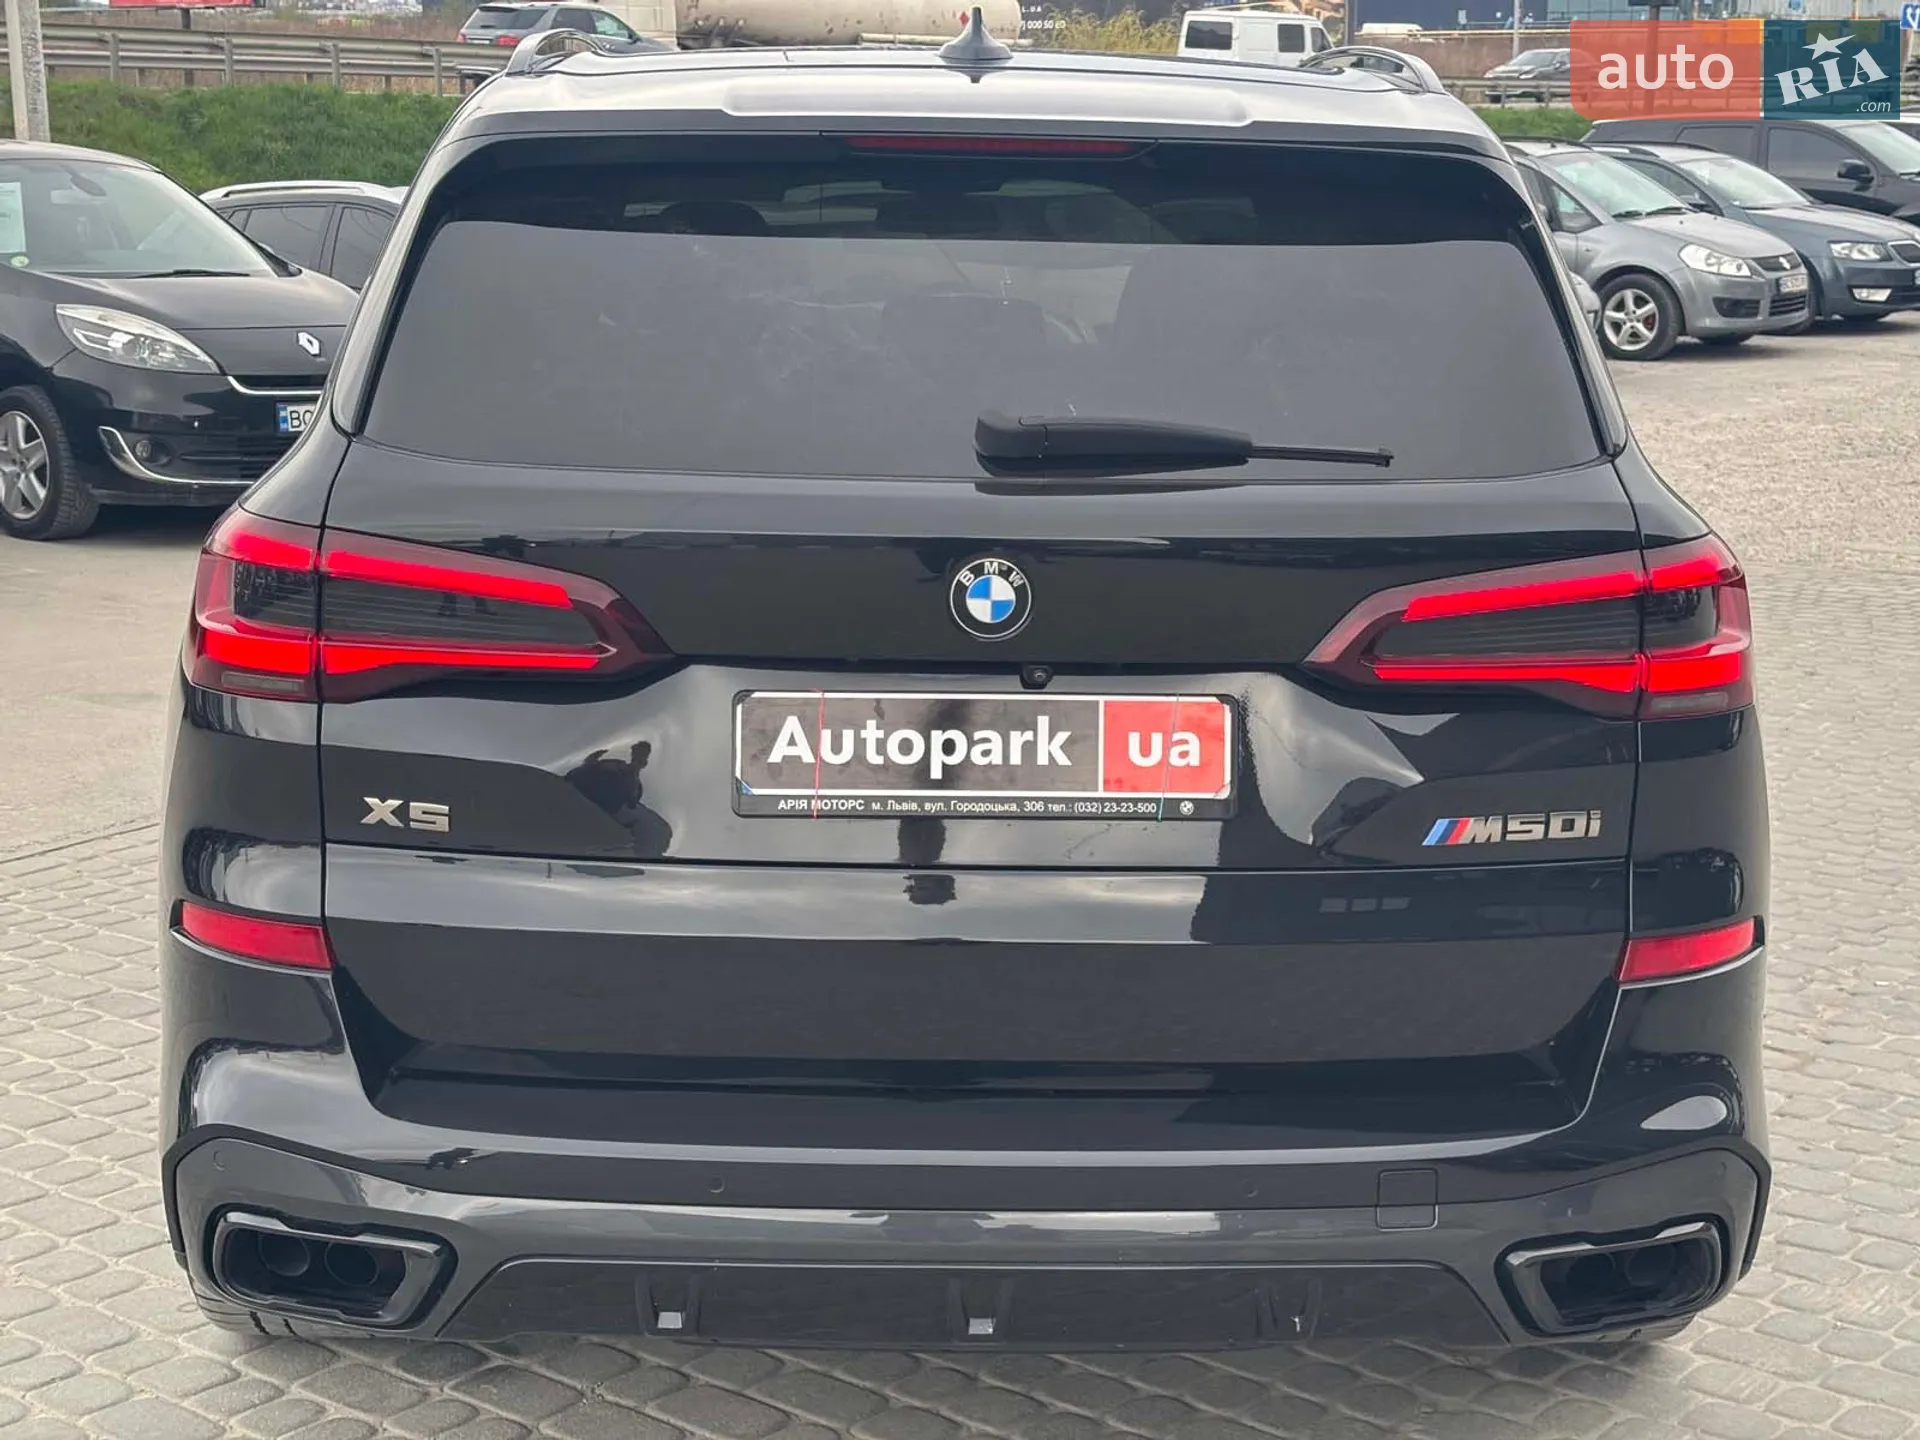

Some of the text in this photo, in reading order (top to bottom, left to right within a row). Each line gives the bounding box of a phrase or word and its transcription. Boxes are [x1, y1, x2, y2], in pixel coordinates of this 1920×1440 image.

[959, 562, 1024, 587] BMW
[767, 715, 1200, 779] Autopark ua
[360, 796, 450, 832] X5
[778, 799, 808, 810] АРІЯ
[811, 799, 865, 811] МОТОРС
[871, 801, 884, 811] м.
[886, 800, 921, 813] Львів,
[924, 802, 947, 813] вул.
[950, 800, 1020, 816] Городоцька,
[1023, 801, 1044, 812] 306
[1074, 801, 1101, 814] (032)
[1103, 802, 1157, 814] 23-23-500
[1458, 810, 1601, 845] M50i
